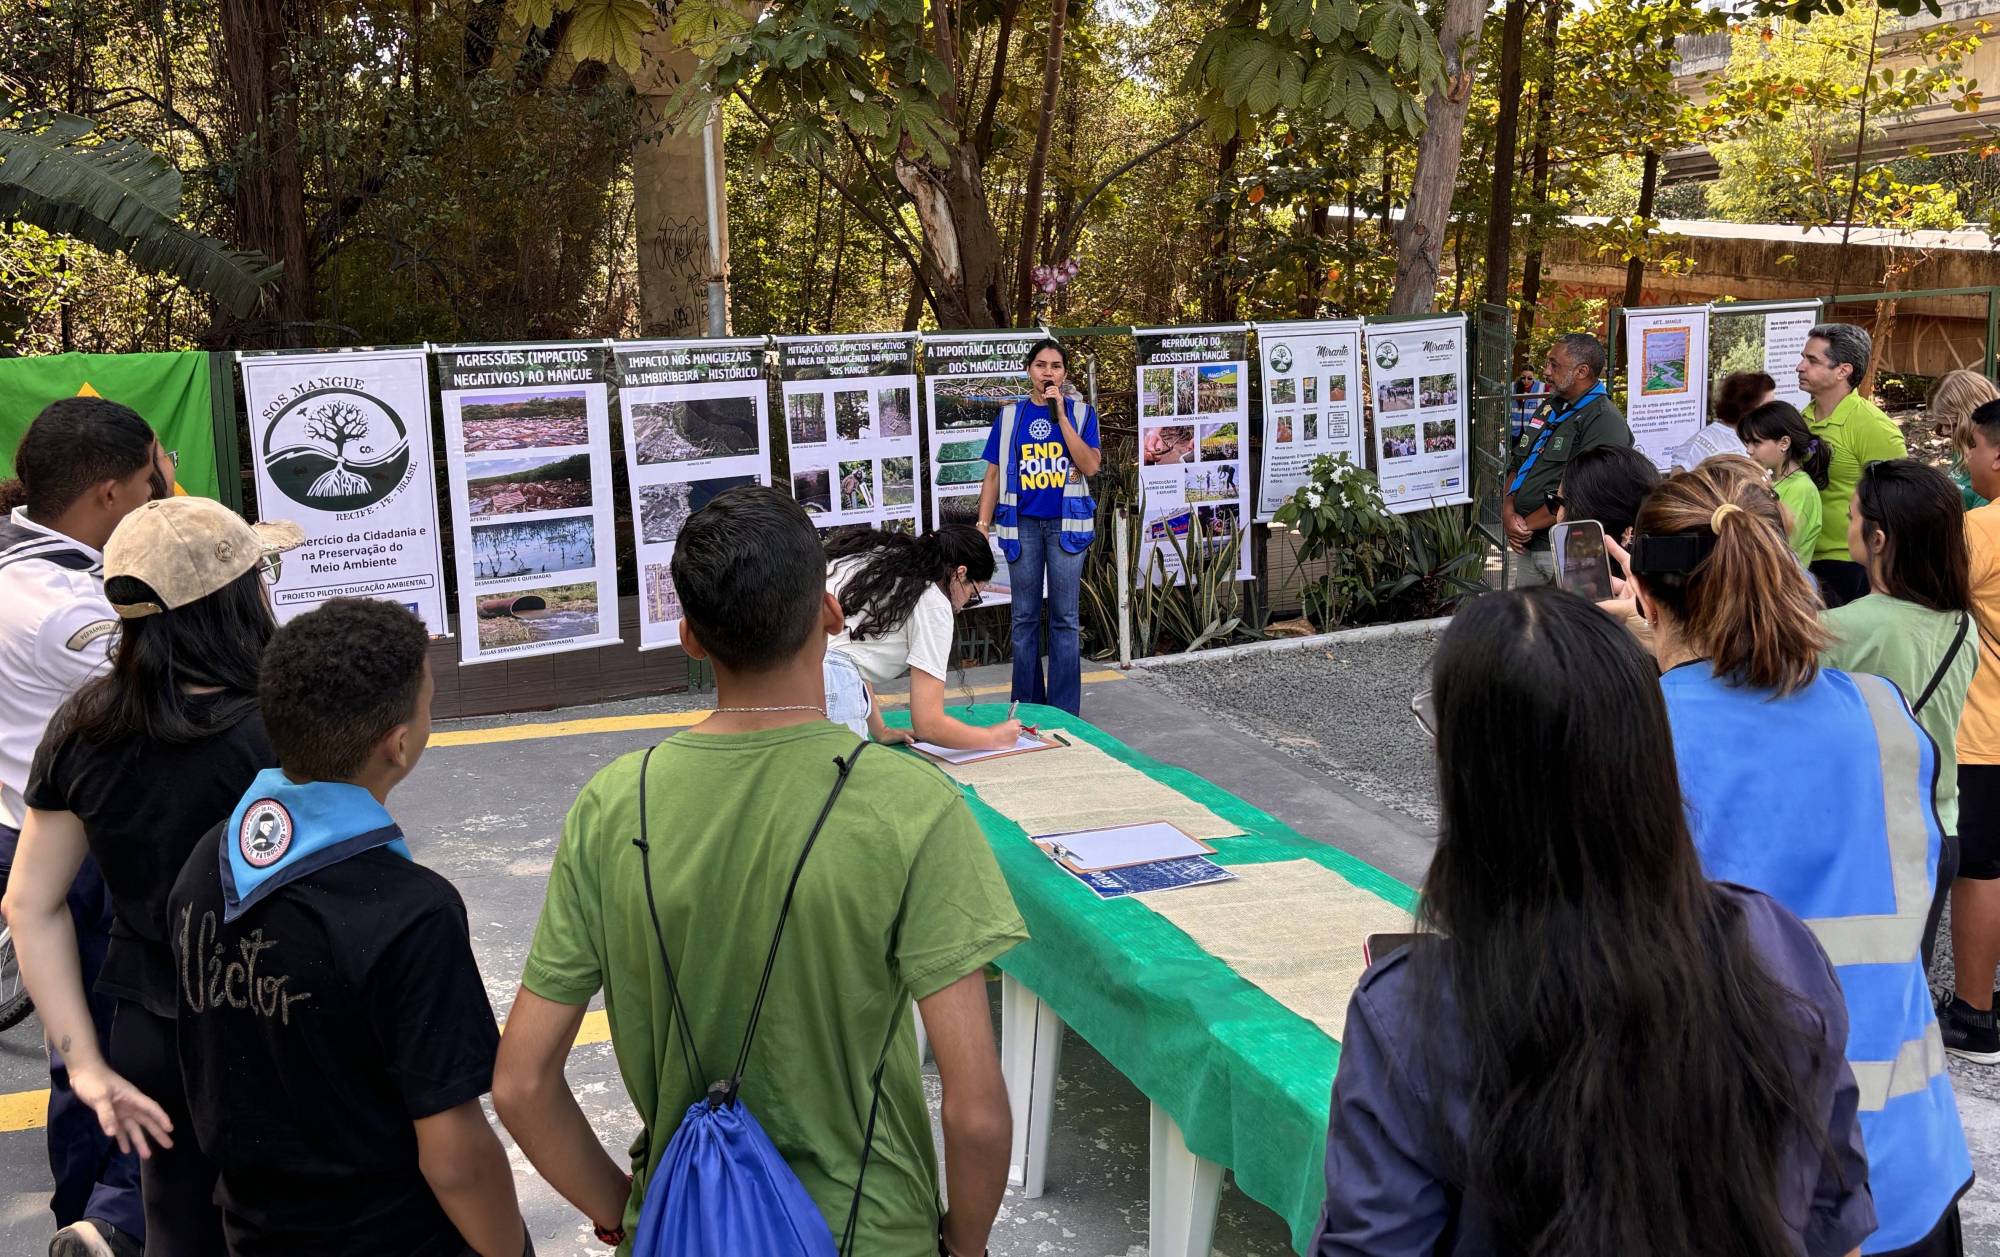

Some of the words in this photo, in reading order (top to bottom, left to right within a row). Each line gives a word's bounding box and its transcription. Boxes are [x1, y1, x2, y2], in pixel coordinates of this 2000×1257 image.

[788, 343, 822, 355] MITIGAÇÃO
[825, 344, 838, 352] DOS
[840, 342, 870, 352] IMPACTOS
[872, 340, 906, 350] NEGATIVOS
[928, 347, 934, 358] A
[936, 342, 994, 357] IMPORTÂNCIA
[997, 341, 1036, 354] ECOLÓGI
[1162, 336, 1208, 348] REPRODUÇÃO
[1210, 336, 1220, 346] DO
[1422, 339, 1455, 353] Mirante
[456, 350, 524, 367] AGRESSÕES
[528, 350, 588, 366] (IMPACTOS
[786, 357, 796, 366] NA
[798, 356, 814, 365] ÁREA
[816, 356, 825, 364] DE
[827, 352, 870, 364] ABRANGÊNCIA
[872, 353, 880, 362] DO
[882, 352, 908, 362] PROJETO
[1152, 352, 1200, 362] ECOSSISTEMA
[1202, 350, 1230, 360] MANGUE
[1316, 344, 1349, 358] Mirante
[629, 356, 668, 368] IMPACTO
[672, 354, 690, 366] NOS
[693, 352, 751, 364] MANGUEZAIS
[949, 362, 968, 374] DOS
[970, 359, 1024, 373] MANGUEZAIS
[454, 370, 524, 387] NEGATIVOS)
[528, 370, 544, 383] AO
[548, 368, 592, 382] MANGUE
[625, 374, 639, 386] NA
[641, 370, 699, 384] IMBIRIBEIRA
[708, 366, 758, 380] HISTÓRICO
[830, 366, 843, 376] SOS
[844, 366, 869, 375] MANGUE
[262, 394, 289, 420] SOS
[290, 376, 365, 398] MANGUE
[1021, 442, 1063, 460] END
[1019, 456, 1069, 476] POLIO
[1020, 472, 1066, 490] NOW
[336, 508, 374, 521] RECIFE
[380, 496, 394, 508] PE
[397, 461, 418, 494] BRASIL
[297, 534, 344, 547] xercício
[347, 532, 360, 543] da
[364, 528, 416, 541] Cidadania
[420, 528, 426, 536] e
[302, 552, 315, 561] na
[319, 545, 386, 560] Preservação
[389, 542, 403, 552] do
[310, 562, 340, 574] Meio
[343, 556, 397, 570] Ambiente
[522, 574, 552, 582] QUEIMADAS
[282, 590, 315, 600] PROJETO
[317, 588, 344, 598] PILOTO
[345, 583, 385, 594] EDUCAÇÃO
[386, 578, 428, 590] AMBIENTAL
[498, 646, 521, 654] SERVIDAS
[536, 638, 574, 648] CONTAMINADAS
[179, 901, 312, 1026] Victor
